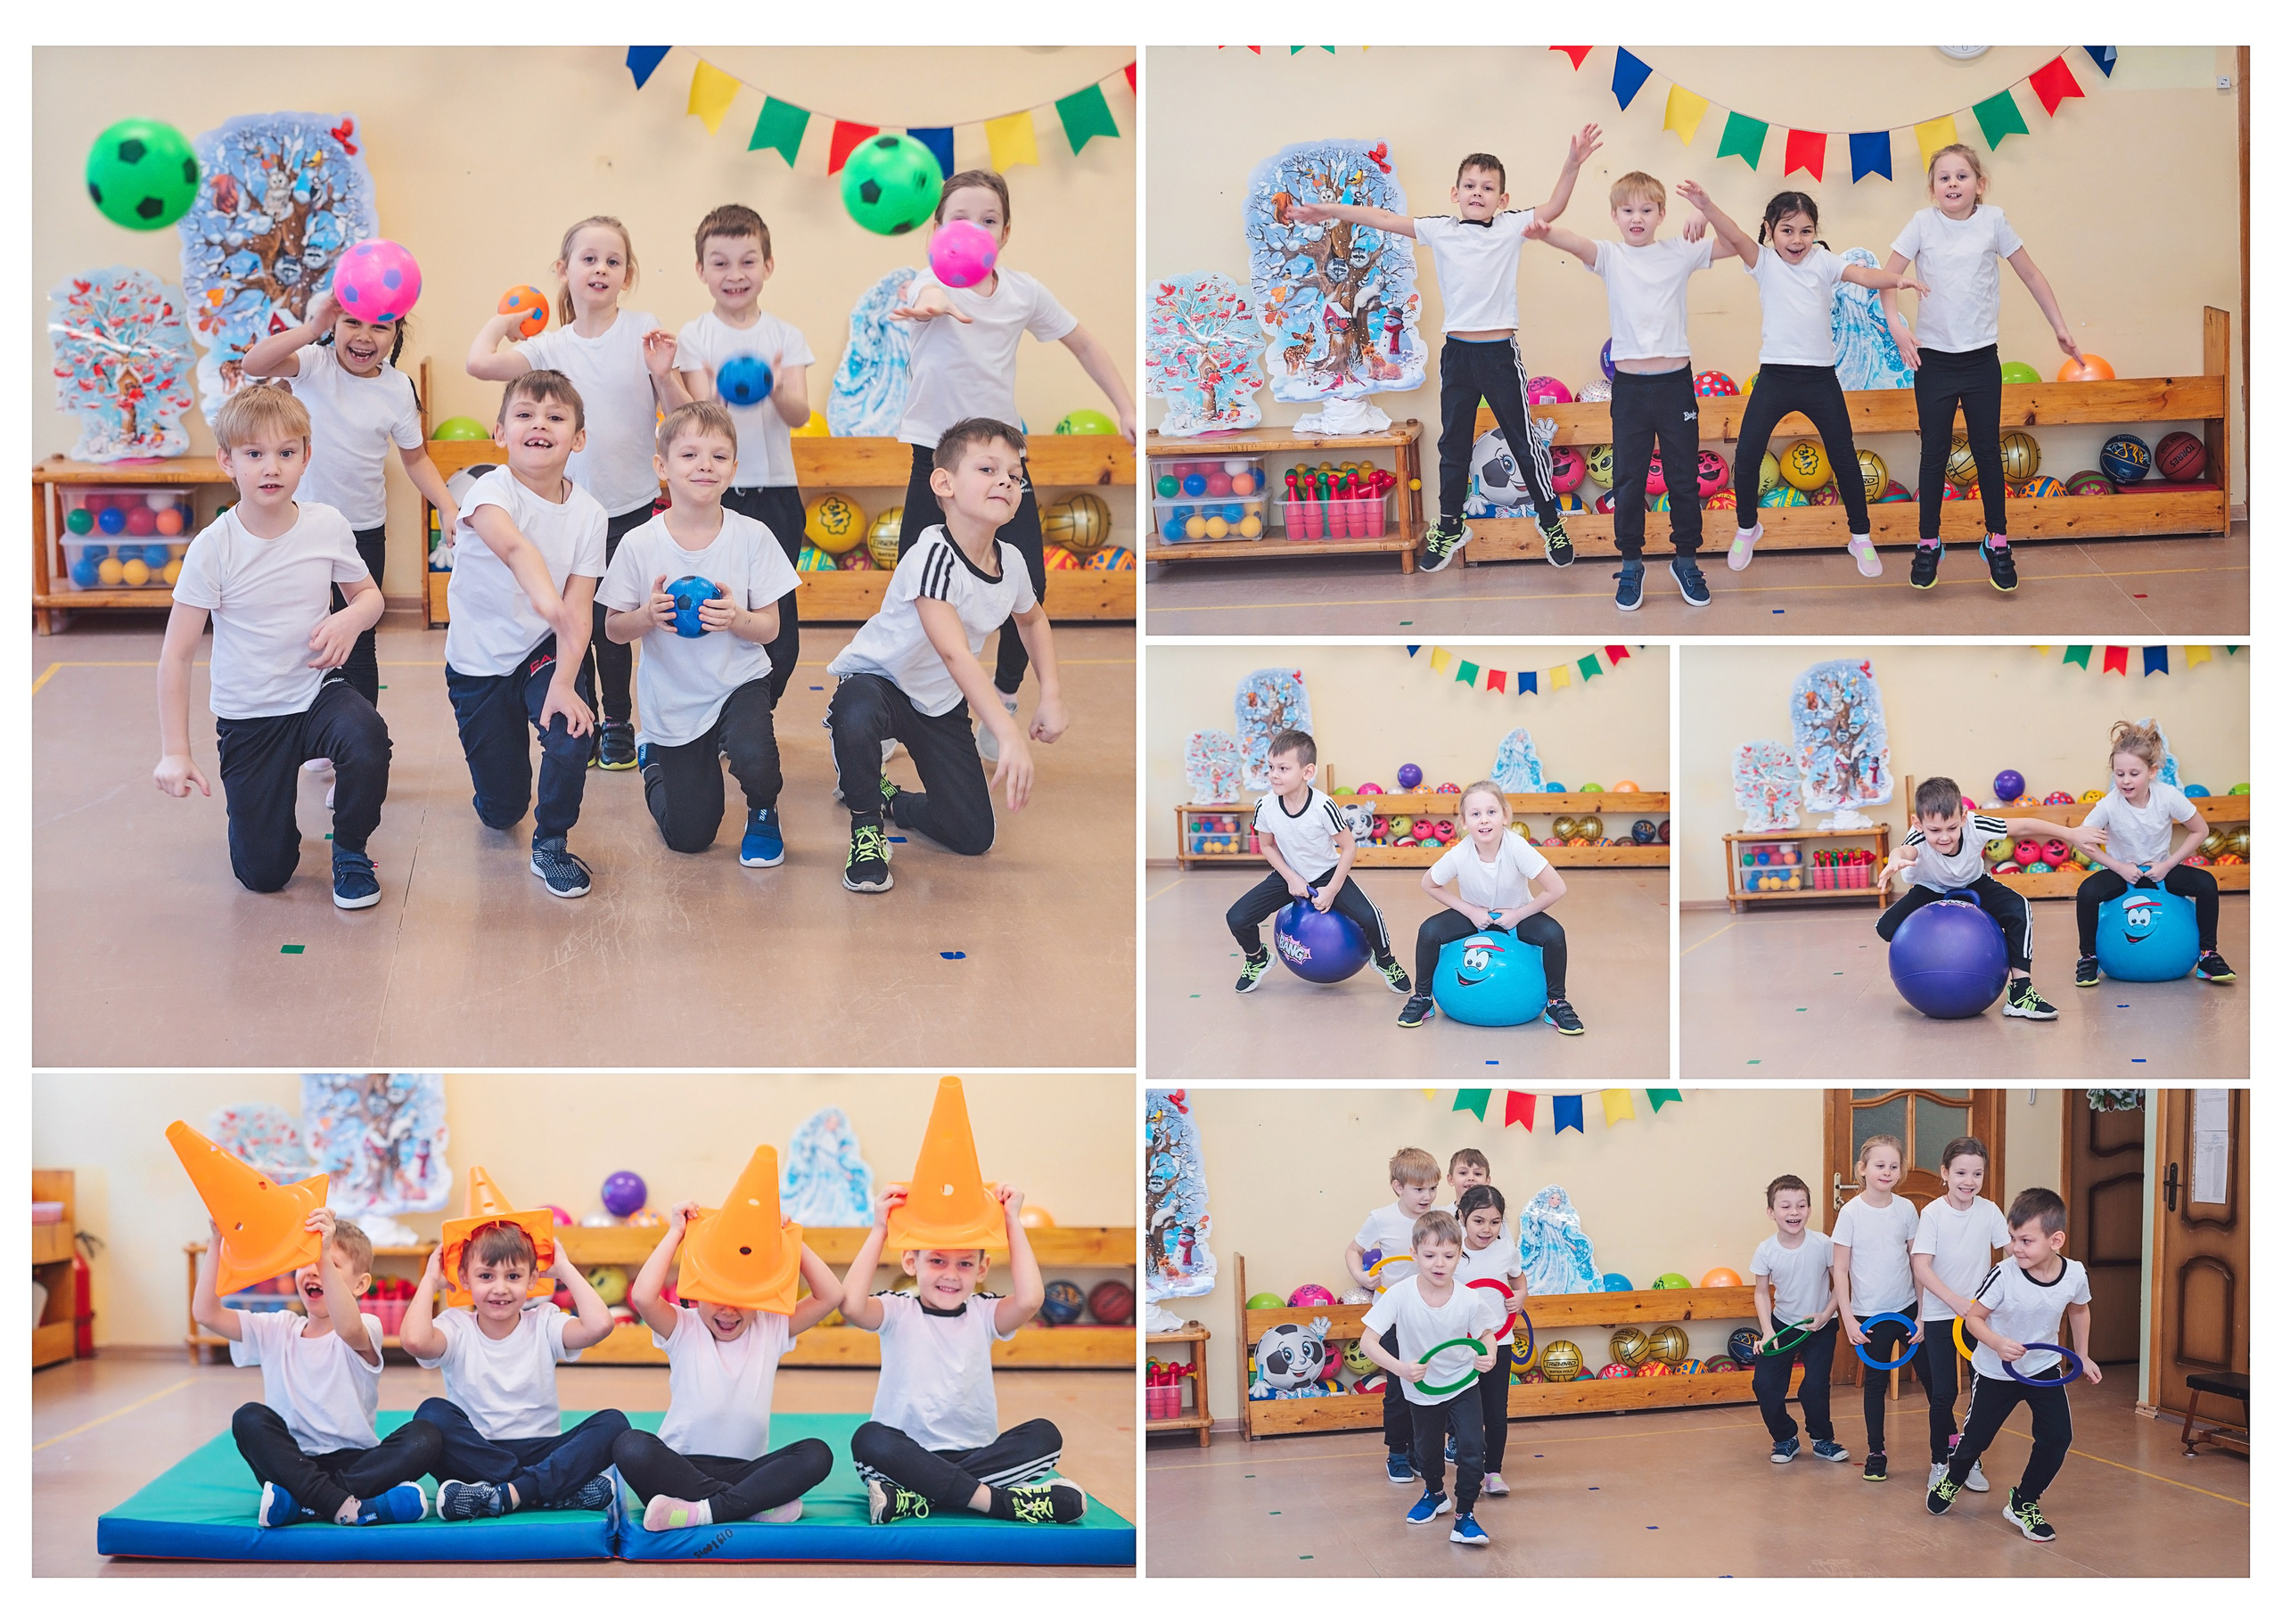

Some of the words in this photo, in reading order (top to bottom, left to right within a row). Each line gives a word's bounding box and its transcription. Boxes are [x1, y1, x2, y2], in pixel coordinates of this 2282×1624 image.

[2170, 443, 2196, 468] TORRES
[529, 654, 556, 674] EA
[1279, 934, 1305, 961] BANG
